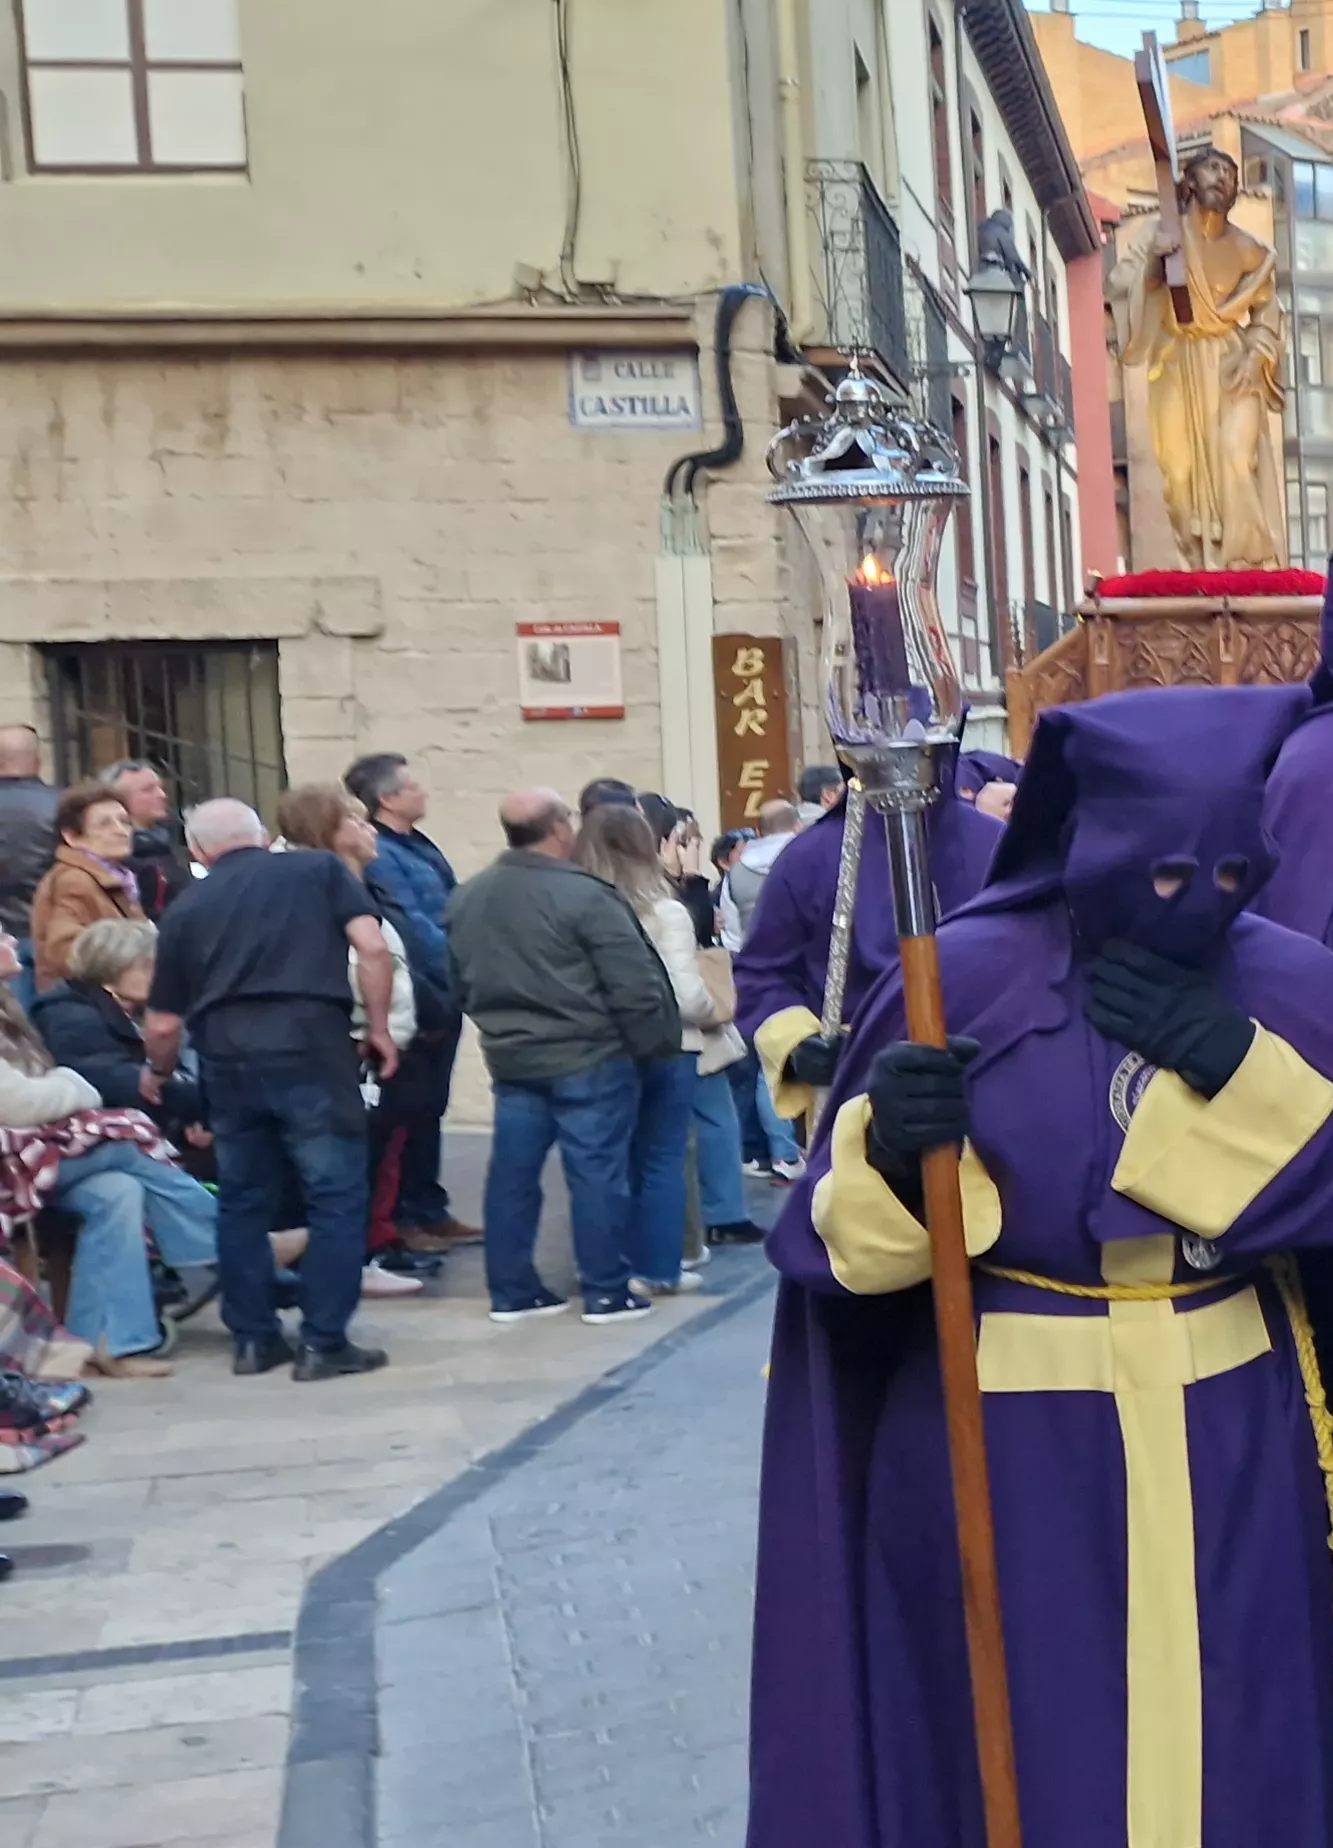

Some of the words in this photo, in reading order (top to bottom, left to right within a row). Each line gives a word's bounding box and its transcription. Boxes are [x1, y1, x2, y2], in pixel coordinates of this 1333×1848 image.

[614, 361, 675, 379] CALLE
[580, 395, 691, 416] CASTILLA
[731, 647, 769, 737] BAR
[738, 759, 770, 818] EL
